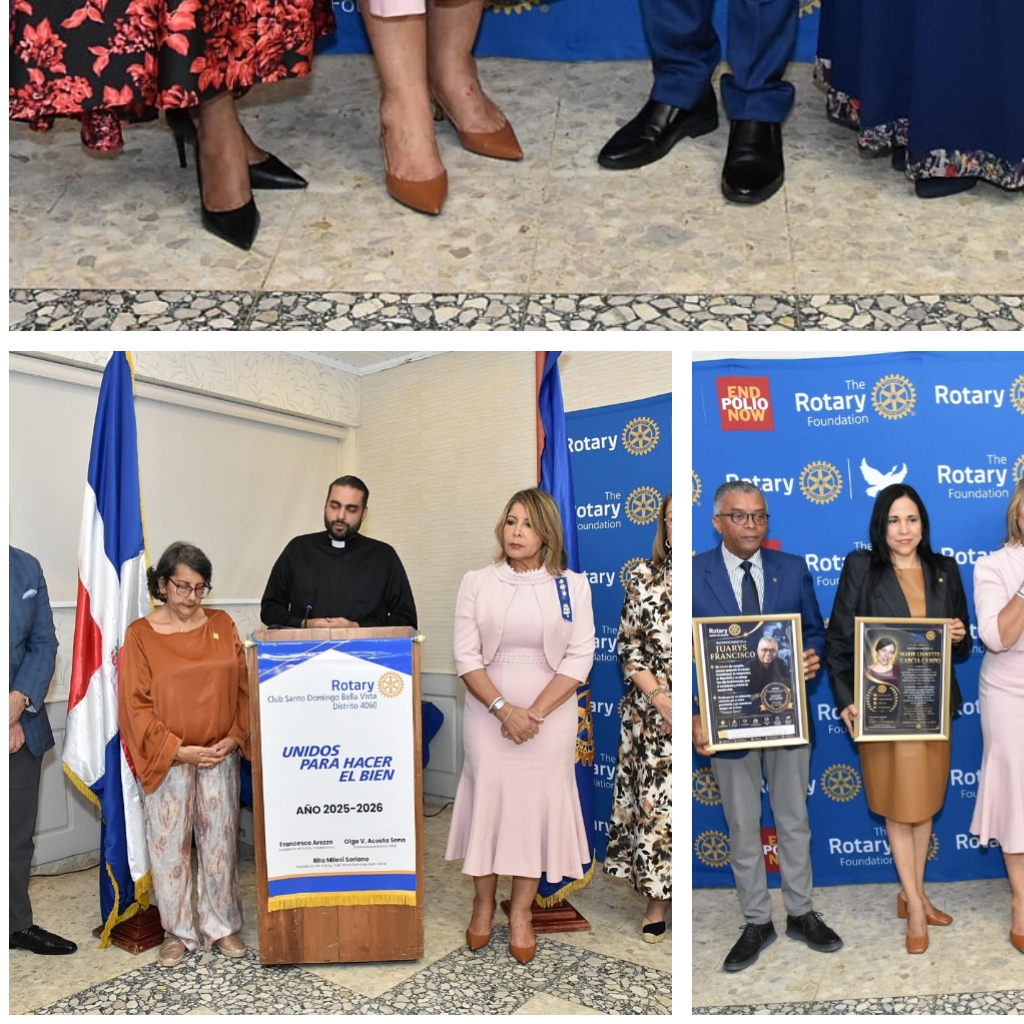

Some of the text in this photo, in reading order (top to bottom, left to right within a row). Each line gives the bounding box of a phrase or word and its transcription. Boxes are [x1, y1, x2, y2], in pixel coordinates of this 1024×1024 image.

[845, 379, 866, 390] The
[727, 386, 761, 398] END
[934, 385, 1005, 408] Rotary
[721, 397, 768, 410] POLIO
[795, 392, 866, 412] Rotary
[728, 409, 765, 422] NOW
[807, 414, 869, 427] Foundation
[987, 454, 1007, 464] The
[937, 465, 1007, 487] Rotary
[605, 492, 621, 500] The
[948, 488, 1009, 498] Foundation
[575, 503, 621, 518] otary
[576, 520, 621, 530] oundation
[601, 625, 617, 635] The
[715, 644, 747, 653] JUARYS
[710, 652, 755, 660] FRANCISCO
[331, 679, 374, 692] Rotary
[267, 695, 283, 703] Club
[307, 694, 339, 704] Domingo
[341, 693, 358, 701] Bella
[360, 692, 377, 700] Vista
[282, 745, 341, 758] UNIDOS
[300, 756, 392, 769] PARA HACER
[600, 753, 616, 763] The
[339, 769, 395, 782] EL BIEN
[296, 803, 383, 815] AÑO 2025-2026
